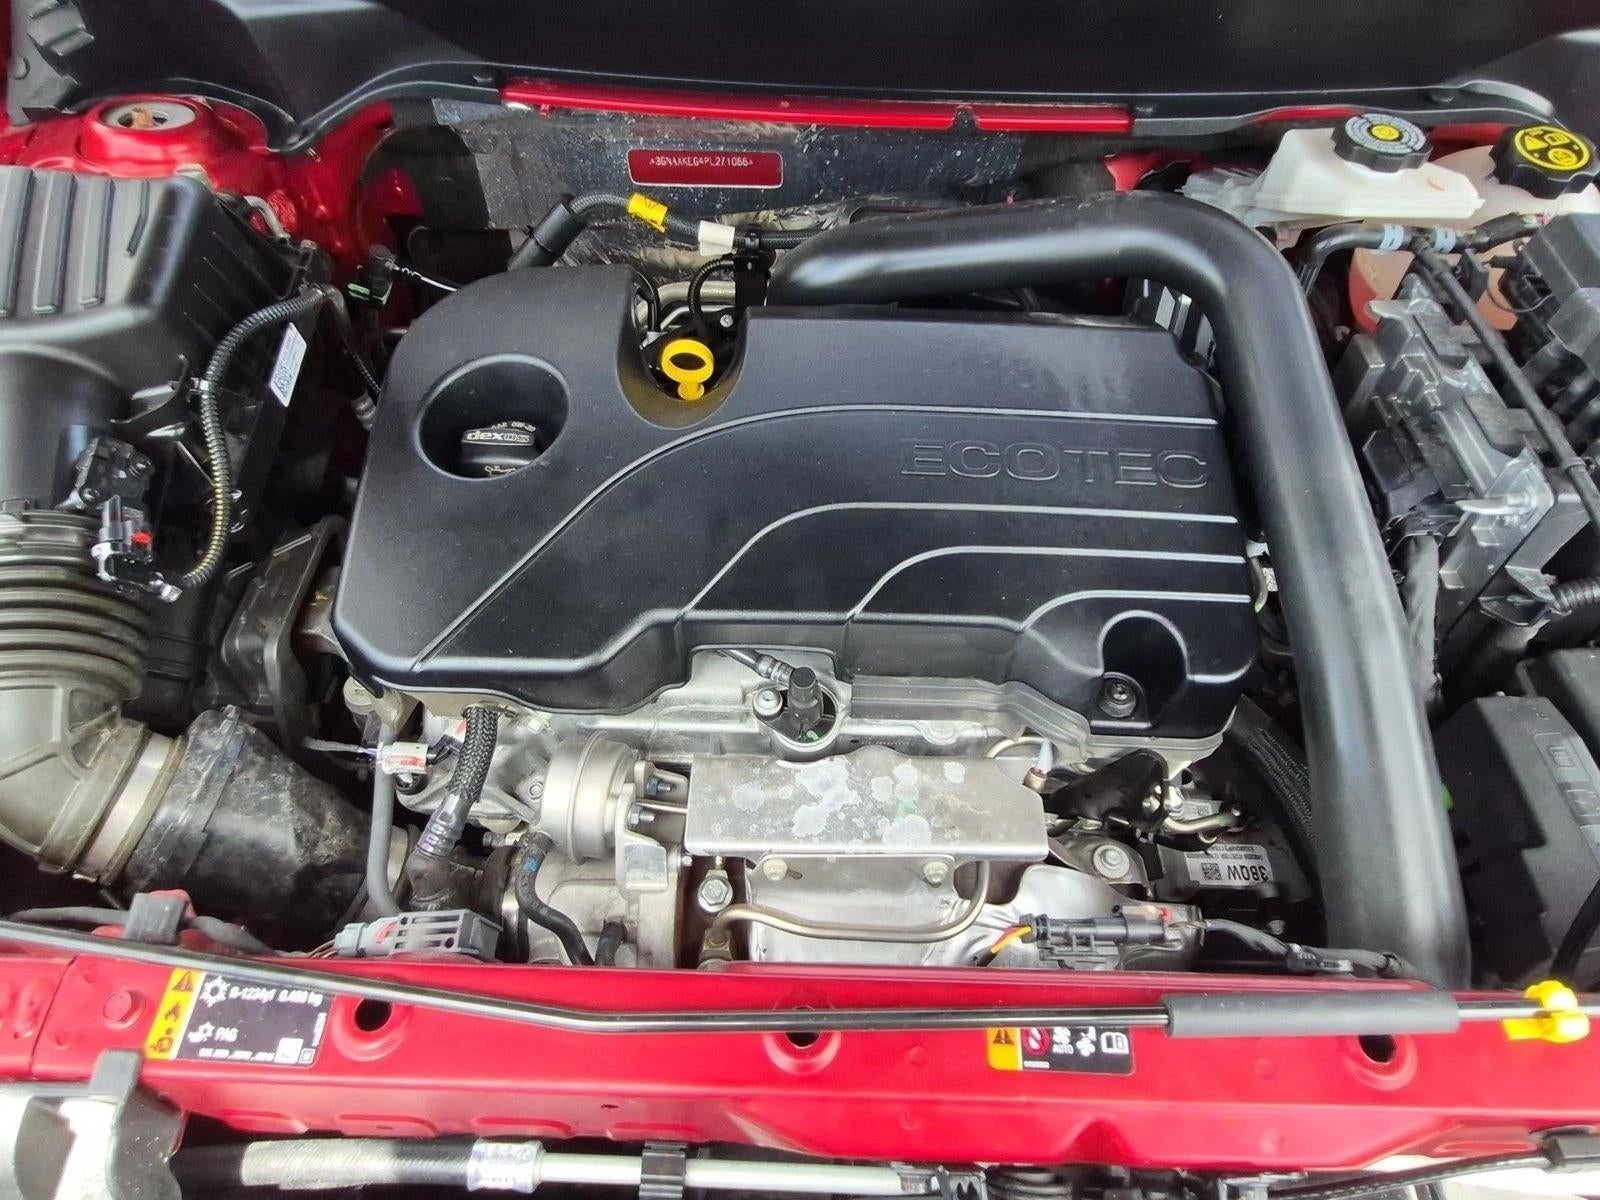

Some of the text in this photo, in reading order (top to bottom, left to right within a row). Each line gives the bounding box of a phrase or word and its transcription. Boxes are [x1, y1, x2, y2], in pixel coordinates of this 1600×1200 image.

[466, 430, 531, 443] dexos
[900, 440, 1208, 489] ECOTEC
[1052, 1043, 1075, 1055] AUTO
